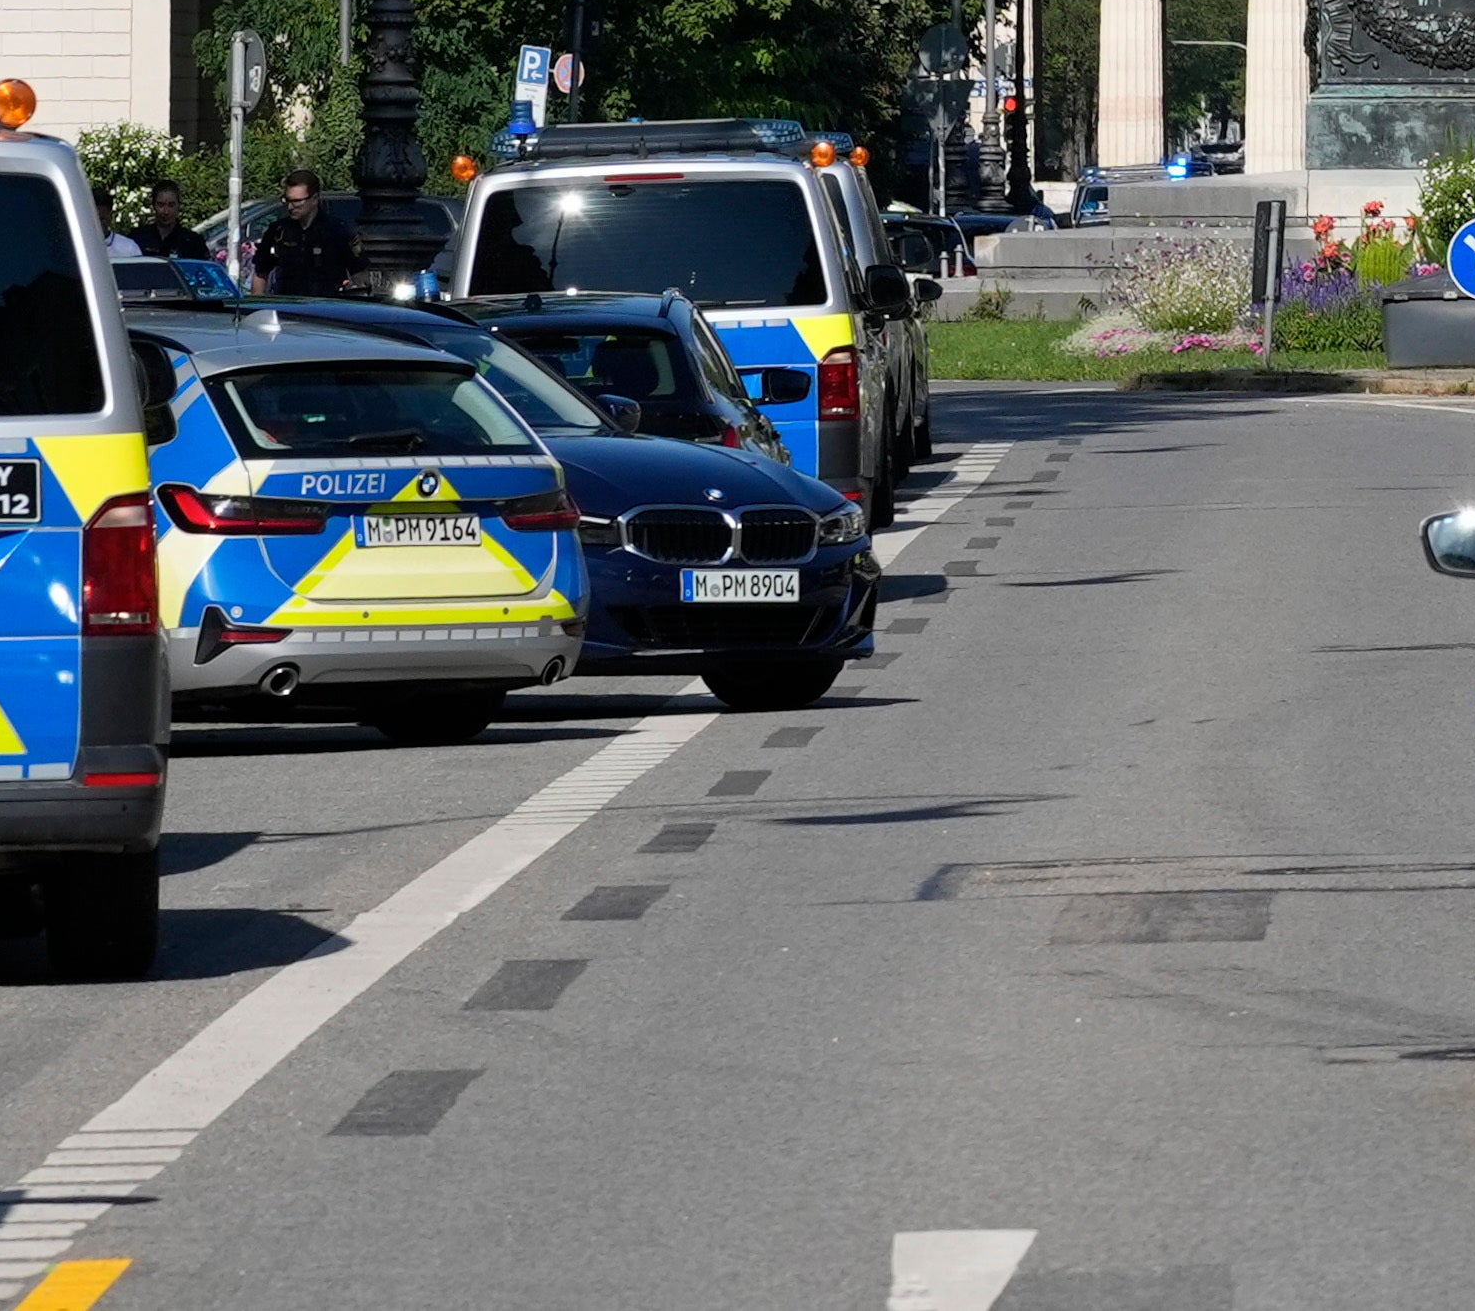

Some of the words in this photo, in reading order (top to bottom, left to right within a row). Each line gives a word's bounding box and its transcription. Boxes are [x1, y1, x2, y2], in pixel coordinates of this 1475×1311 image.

[301, 473, 386, 496] POLIZEI
[367, 518, 381, 542] M
[395, 517, 422, 542] PM
[427, 517, 477, 541] 9164
[695, 574, 708, 597] M
[722, 574, 746, 597] PM
[750, 574, 795, 597] 8904
